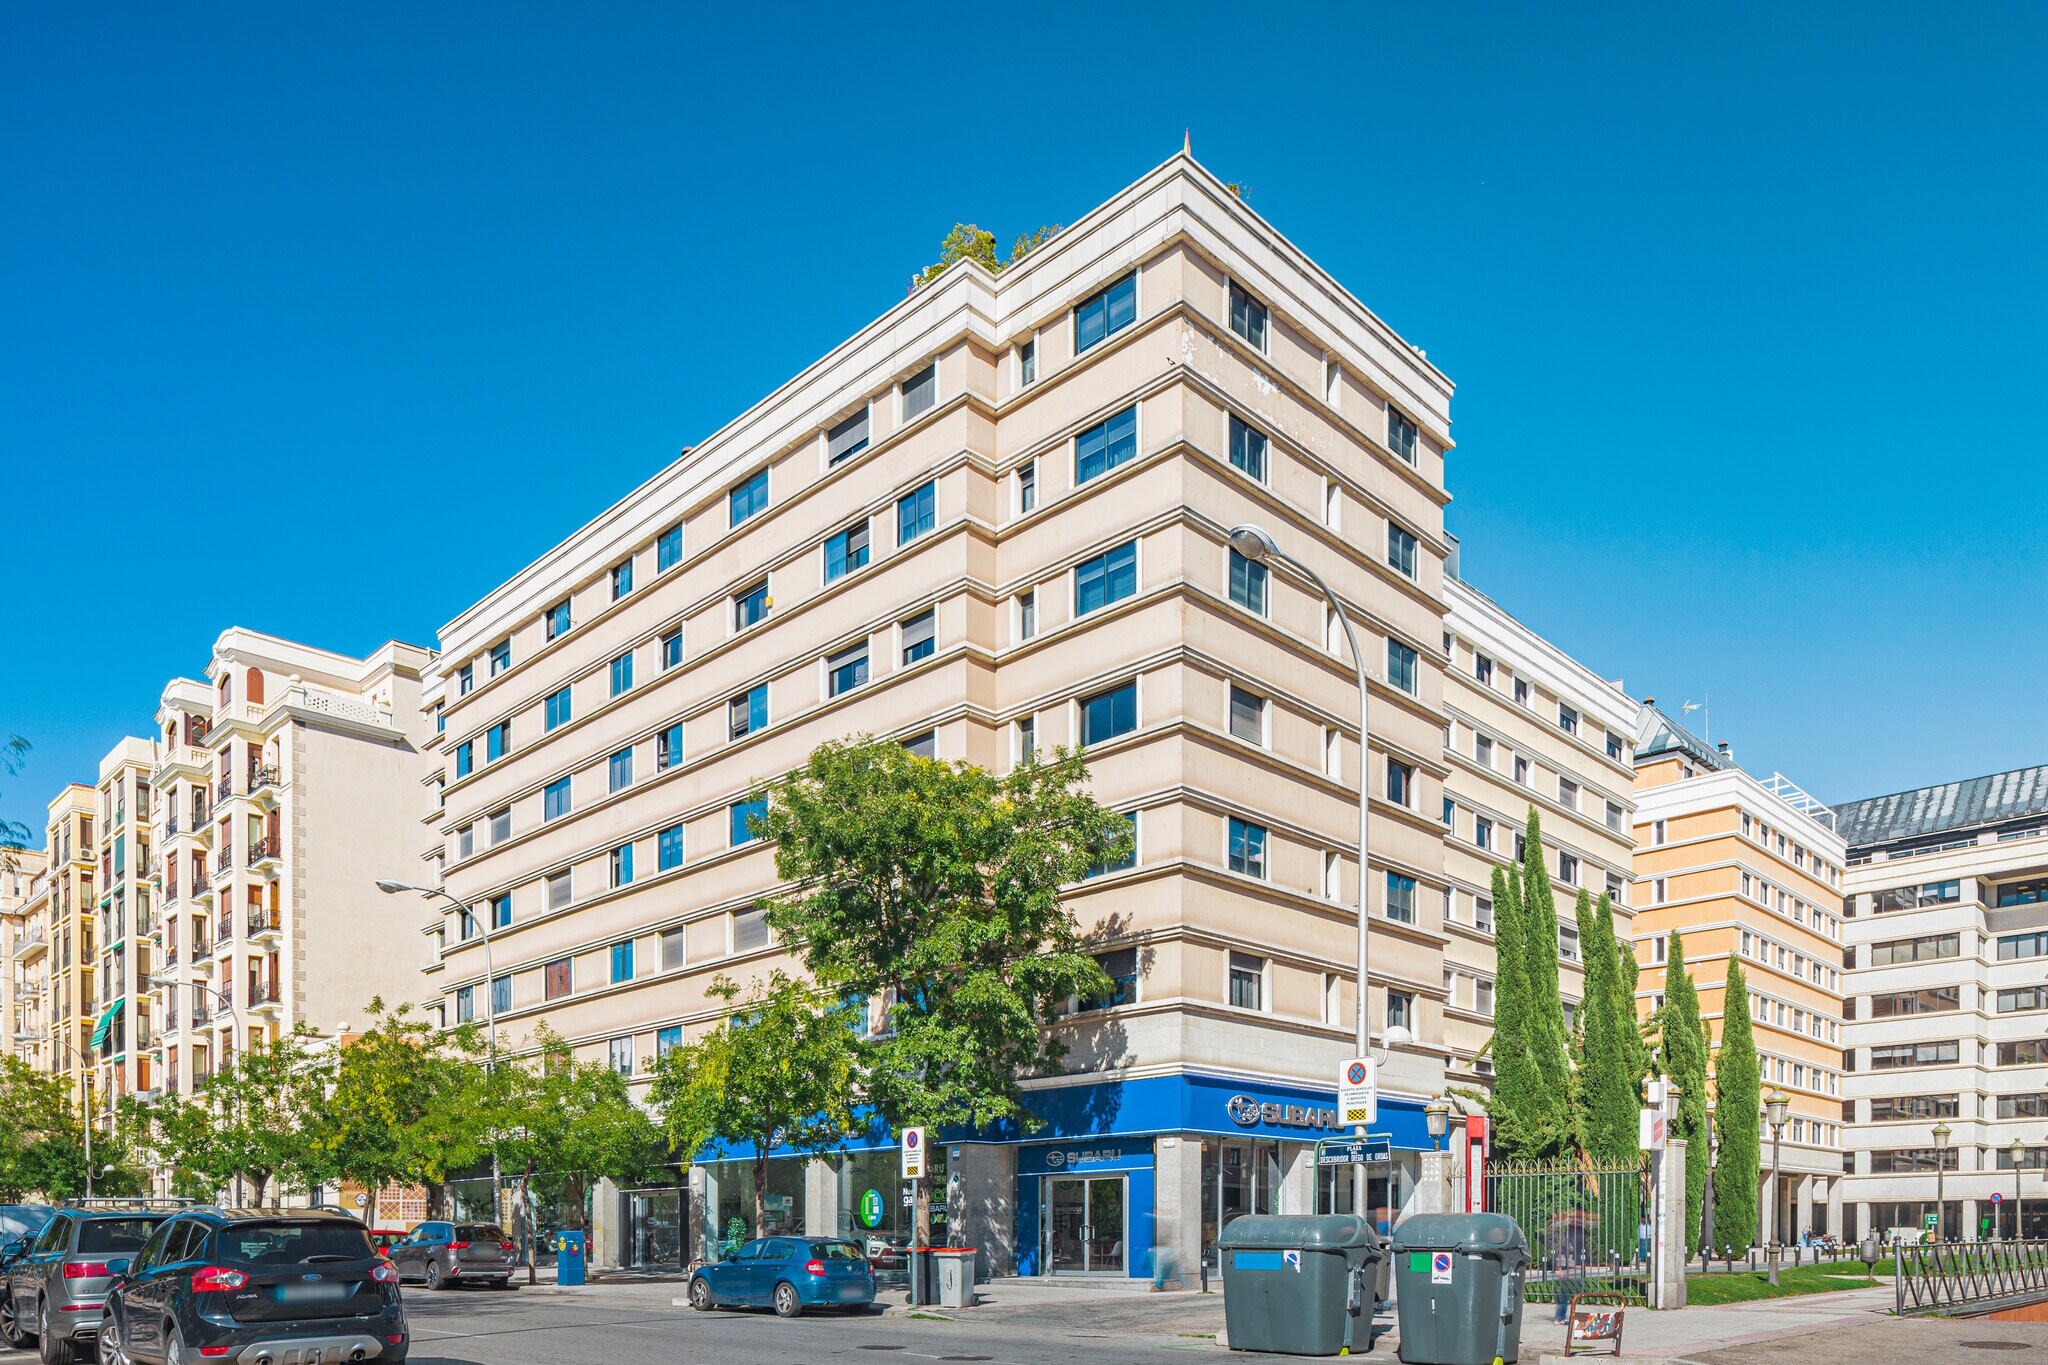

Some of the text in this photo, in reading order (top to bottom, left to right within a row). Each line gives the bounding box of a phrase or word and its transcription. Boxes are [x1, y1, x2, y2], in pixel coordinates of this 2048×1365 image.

[1067, 1149, 1121, 1163] SUBARU
[1320, 1155, 1349, 1164] DESCUBRIDOR
[1351, 1154, 1364, 1162] DIEGO
[1366, 1153, 1372, 1161] DE
